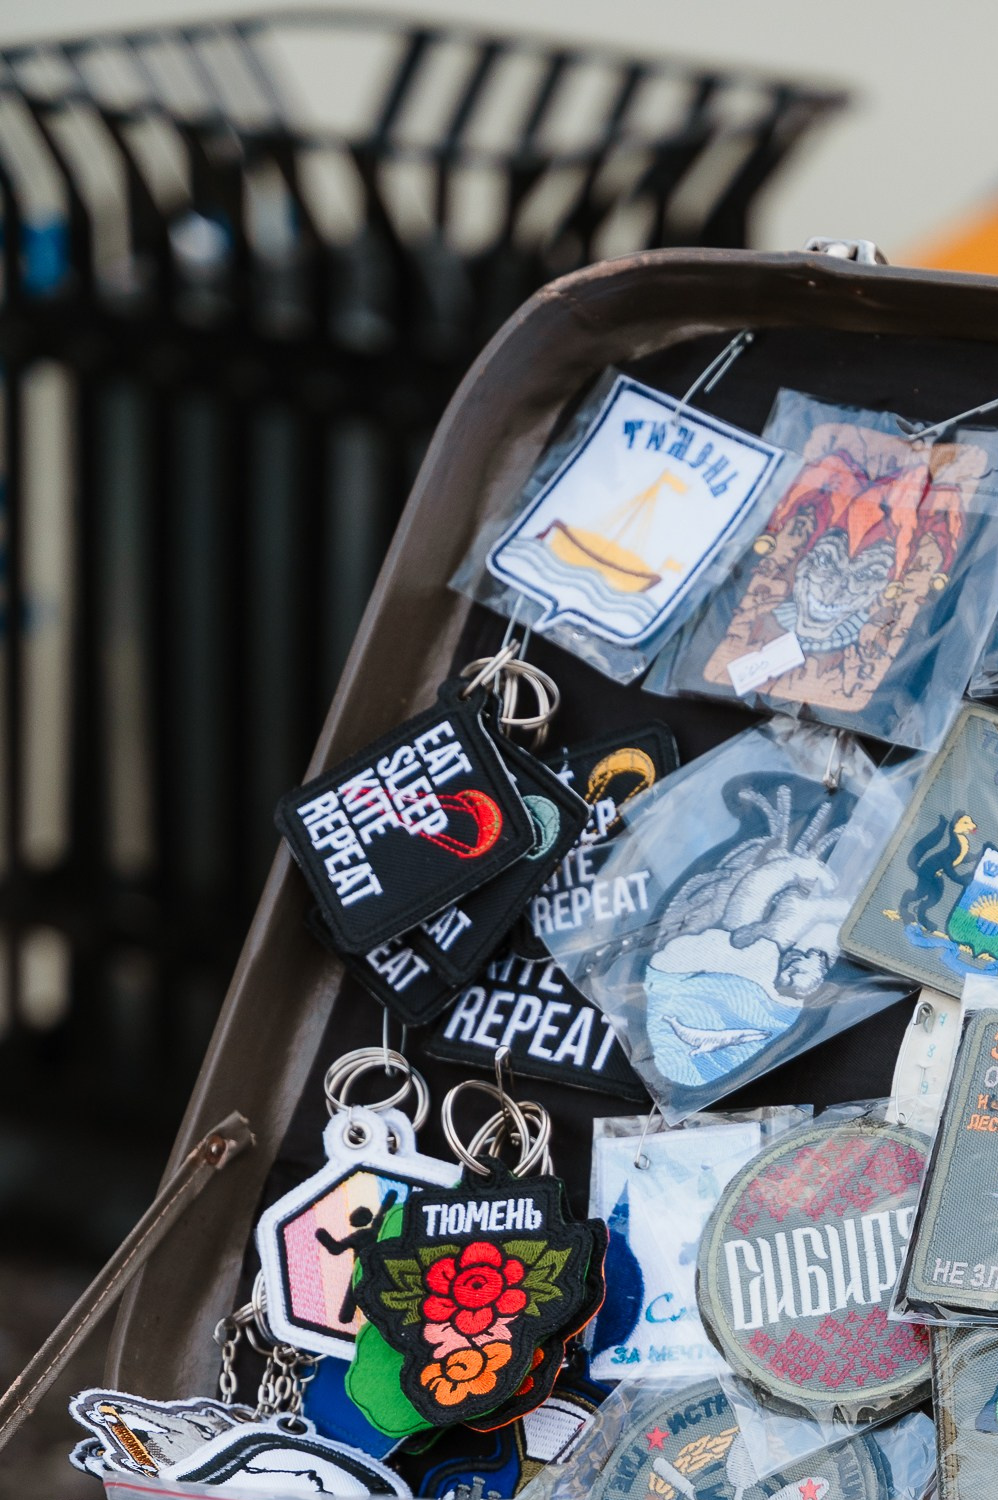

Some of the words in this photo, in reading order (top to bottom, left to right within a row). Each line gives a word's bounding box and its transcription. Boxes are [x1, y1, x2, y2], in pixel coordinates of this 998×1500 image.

[414, 721, 472, 785] EAT
[339, 769, 398, 846] KITE
[377, 745, 449, 836] SLEEP
[297, 791, 383, 907] REPEAT
[531, 870, 650, 936] REPEAT
[443, 985, 627, 1070] REPEAT
[422, 1197, 543, 1236] ТЮМЕНЬ
[932, 1258, 968, 1285] НЕ
[611, 1346, 640, 1364] ЗА
[667, 1393, 729, 1435] ИСТР
